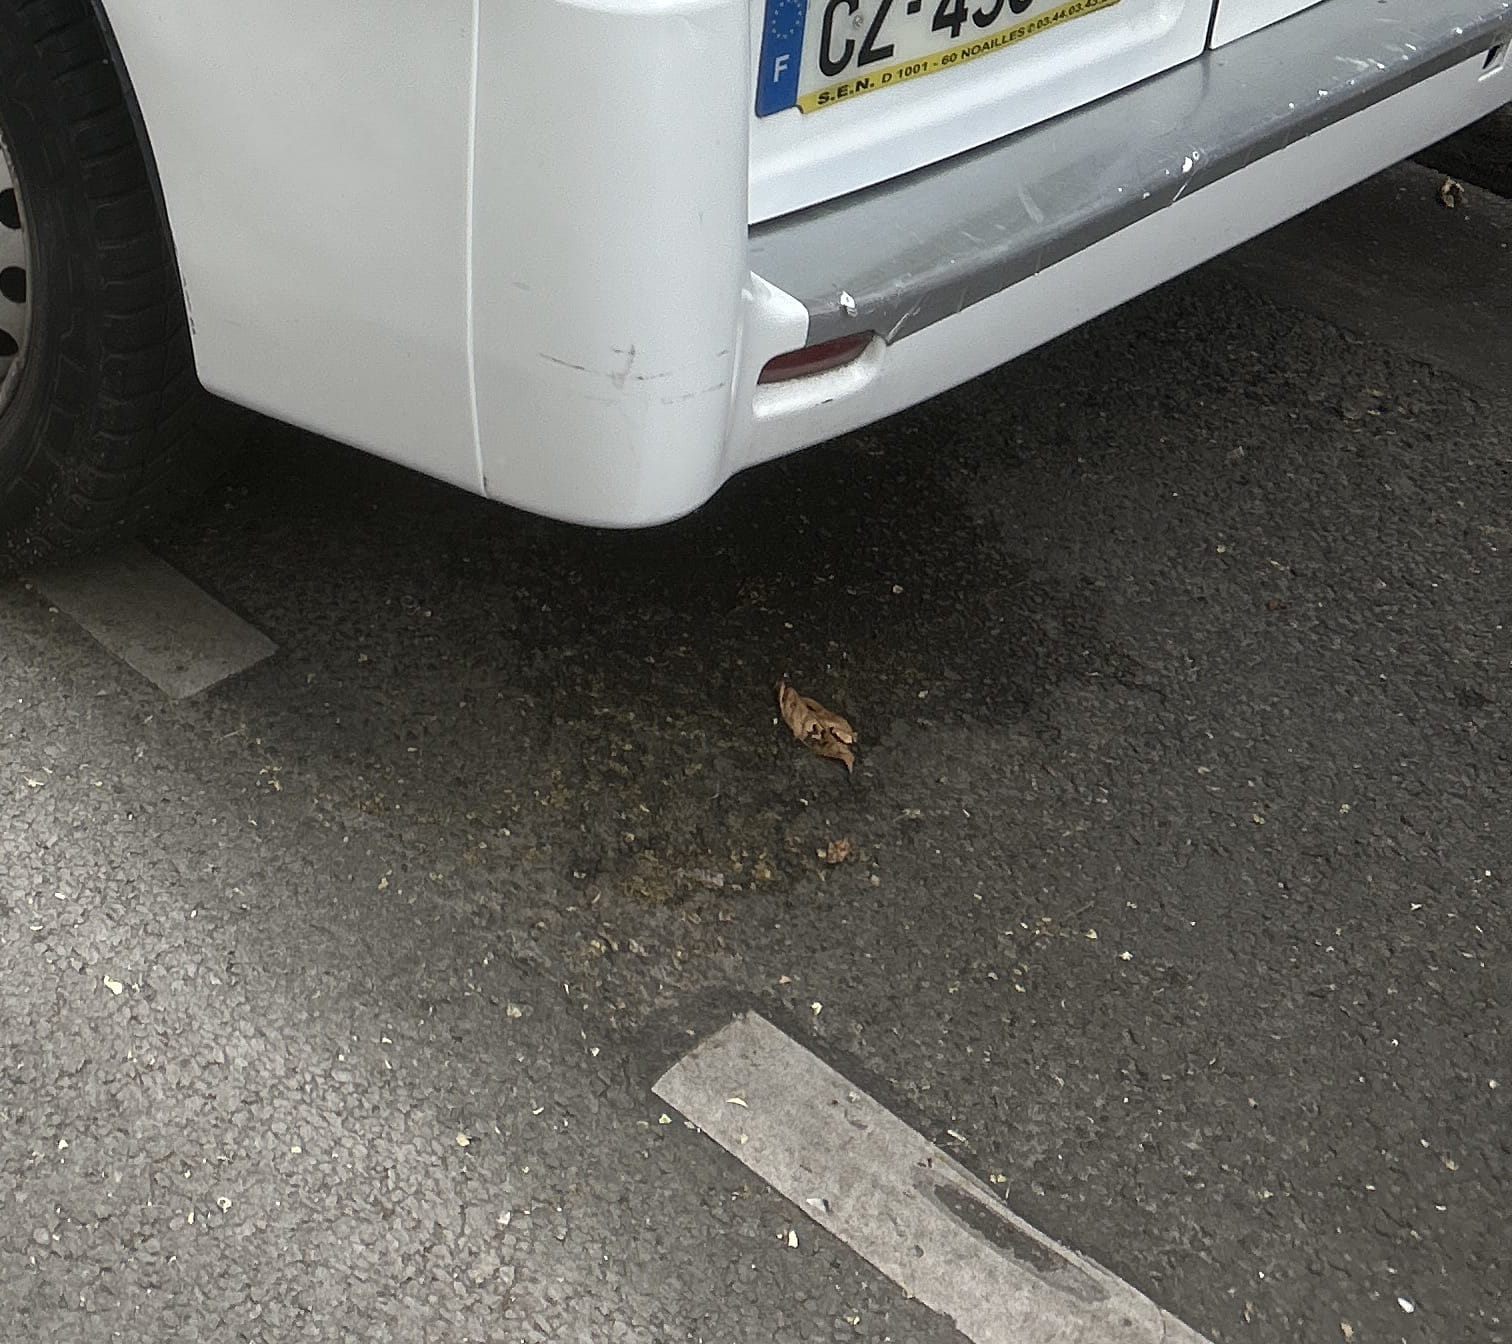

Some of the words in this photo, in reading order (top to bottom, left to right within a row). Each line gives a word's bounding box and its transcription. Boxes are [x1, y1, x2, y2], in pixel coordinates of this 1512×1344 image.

[773, 54, 790, 83] F
[817, 77, 875, 105] S.E.N.
[881, 72, 893, 84] D
[897, 62, 929, 78] 1001
[941, 53, 958, 65] 60
[961, 26, 1025, 60] NOAILLES
